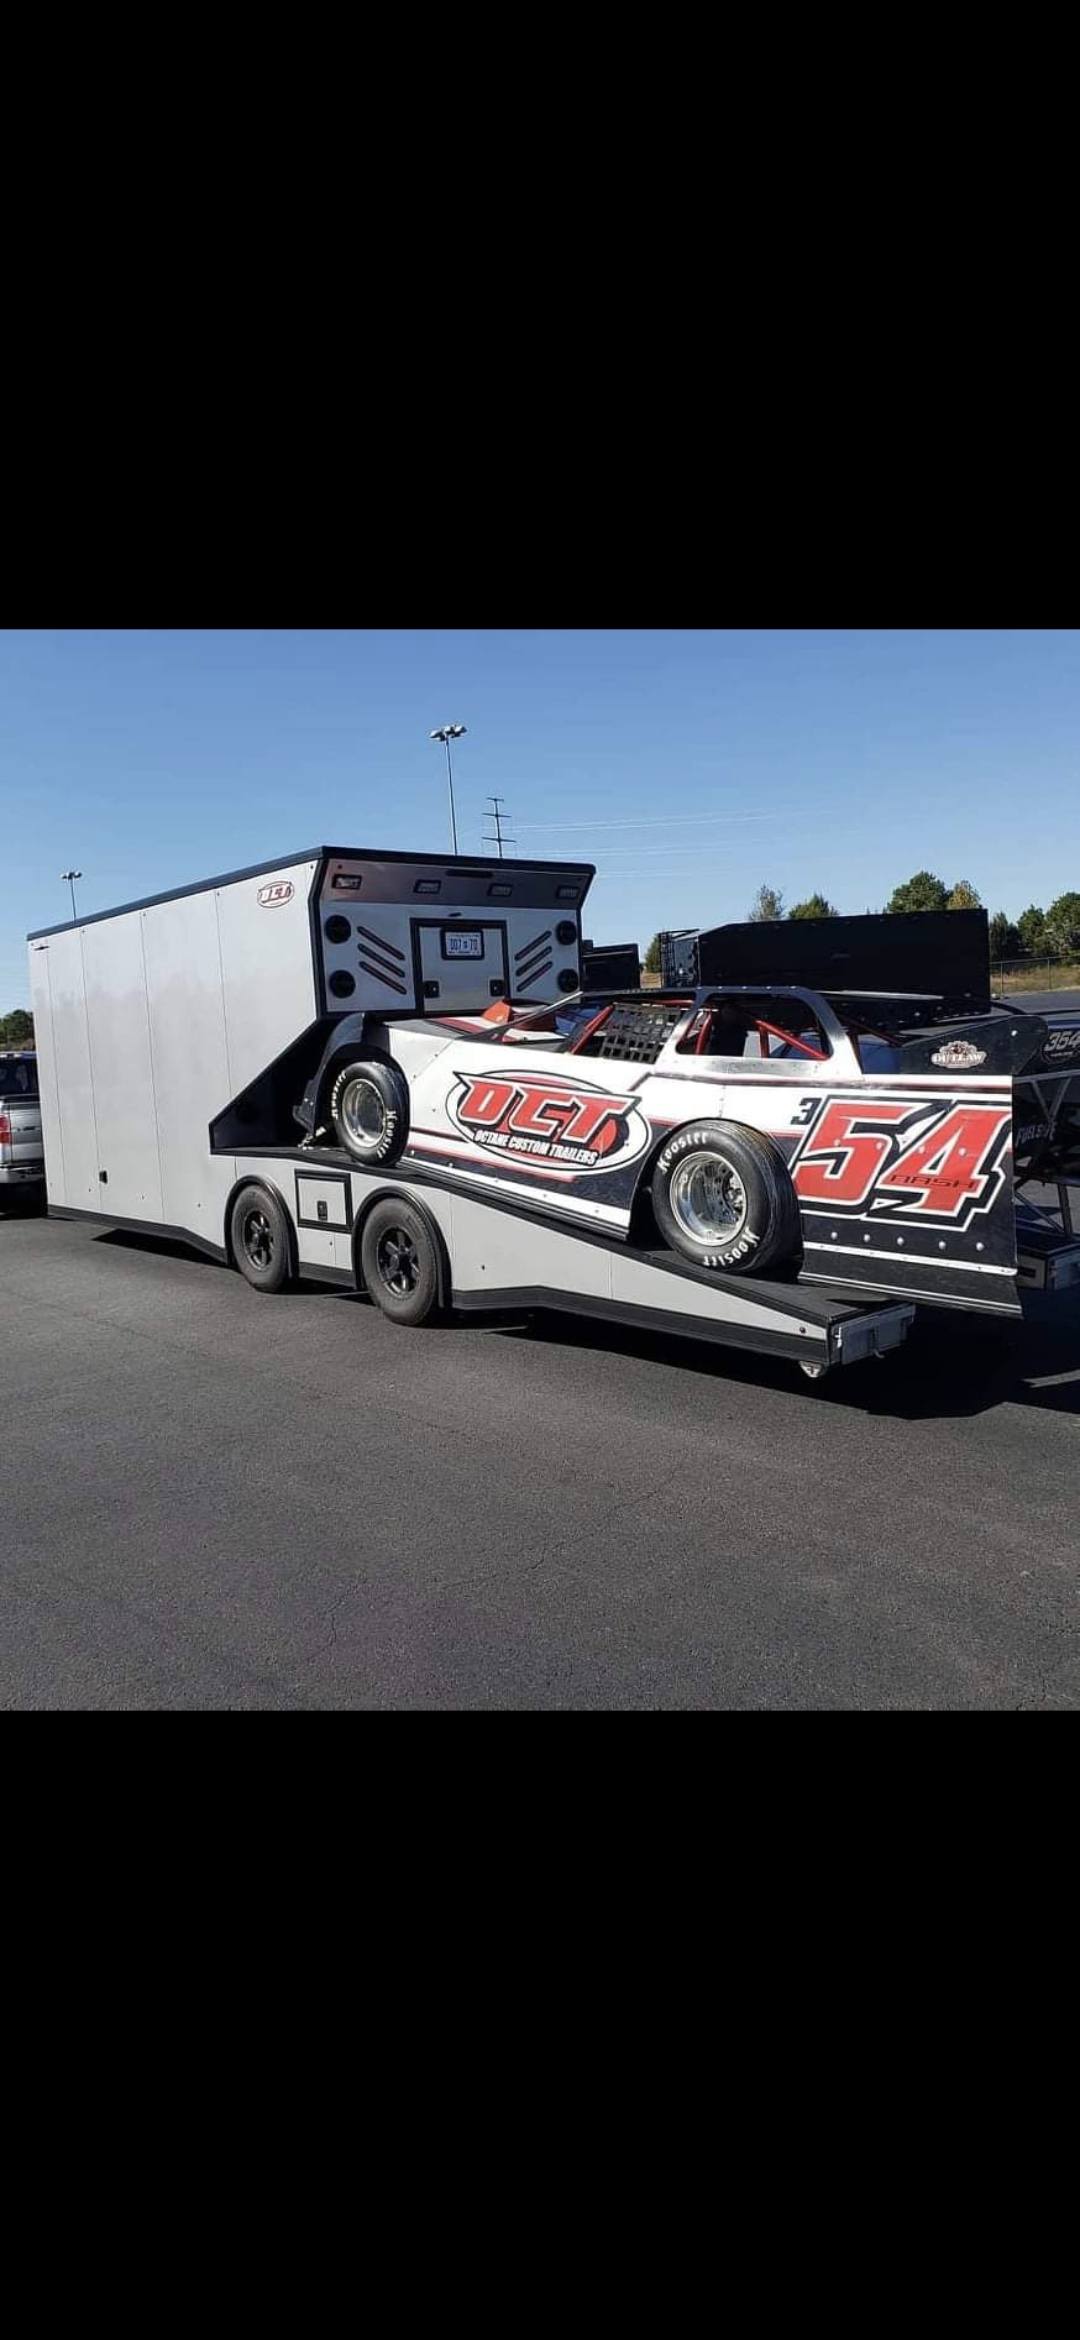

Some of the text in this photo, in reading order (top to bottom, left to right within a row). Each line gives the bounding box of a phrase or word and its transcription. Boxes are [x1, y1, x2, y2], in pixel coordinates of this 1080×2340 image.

[457, 1079, 628, 1144] OCT
[475, 1129, 598, 1164] OCTANE CUSTOM TRAILERS
[790, 1097, 1012, 1220] 3 54
